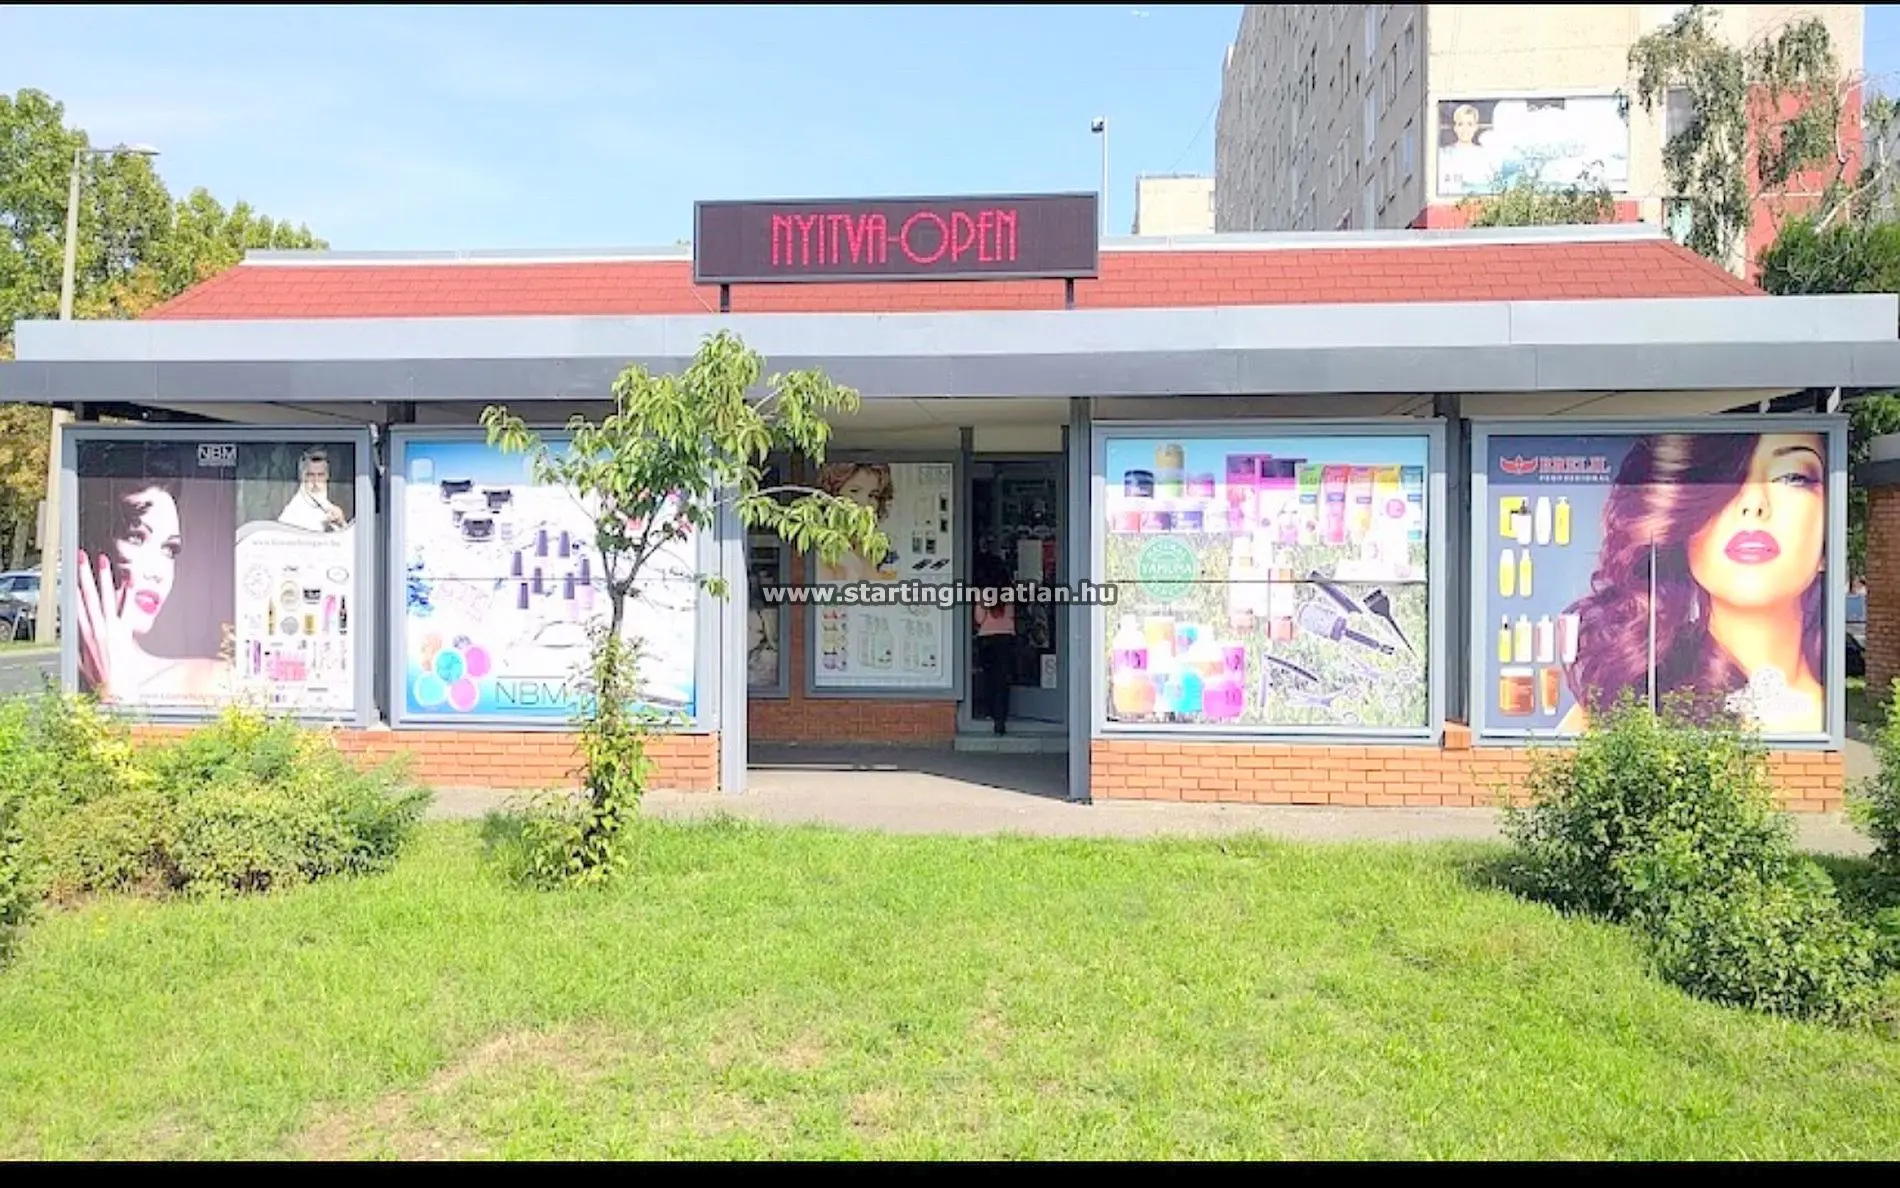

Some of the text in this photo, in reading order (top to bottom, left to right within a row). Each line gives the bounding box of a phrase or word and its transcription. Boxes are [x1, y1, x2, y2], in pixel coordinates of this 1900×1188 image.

[771, 209, 1017, 265] NYITVA-OPEN
[199, 445, 236, 460] NBM
[495, 681, 567, 705] NBM
